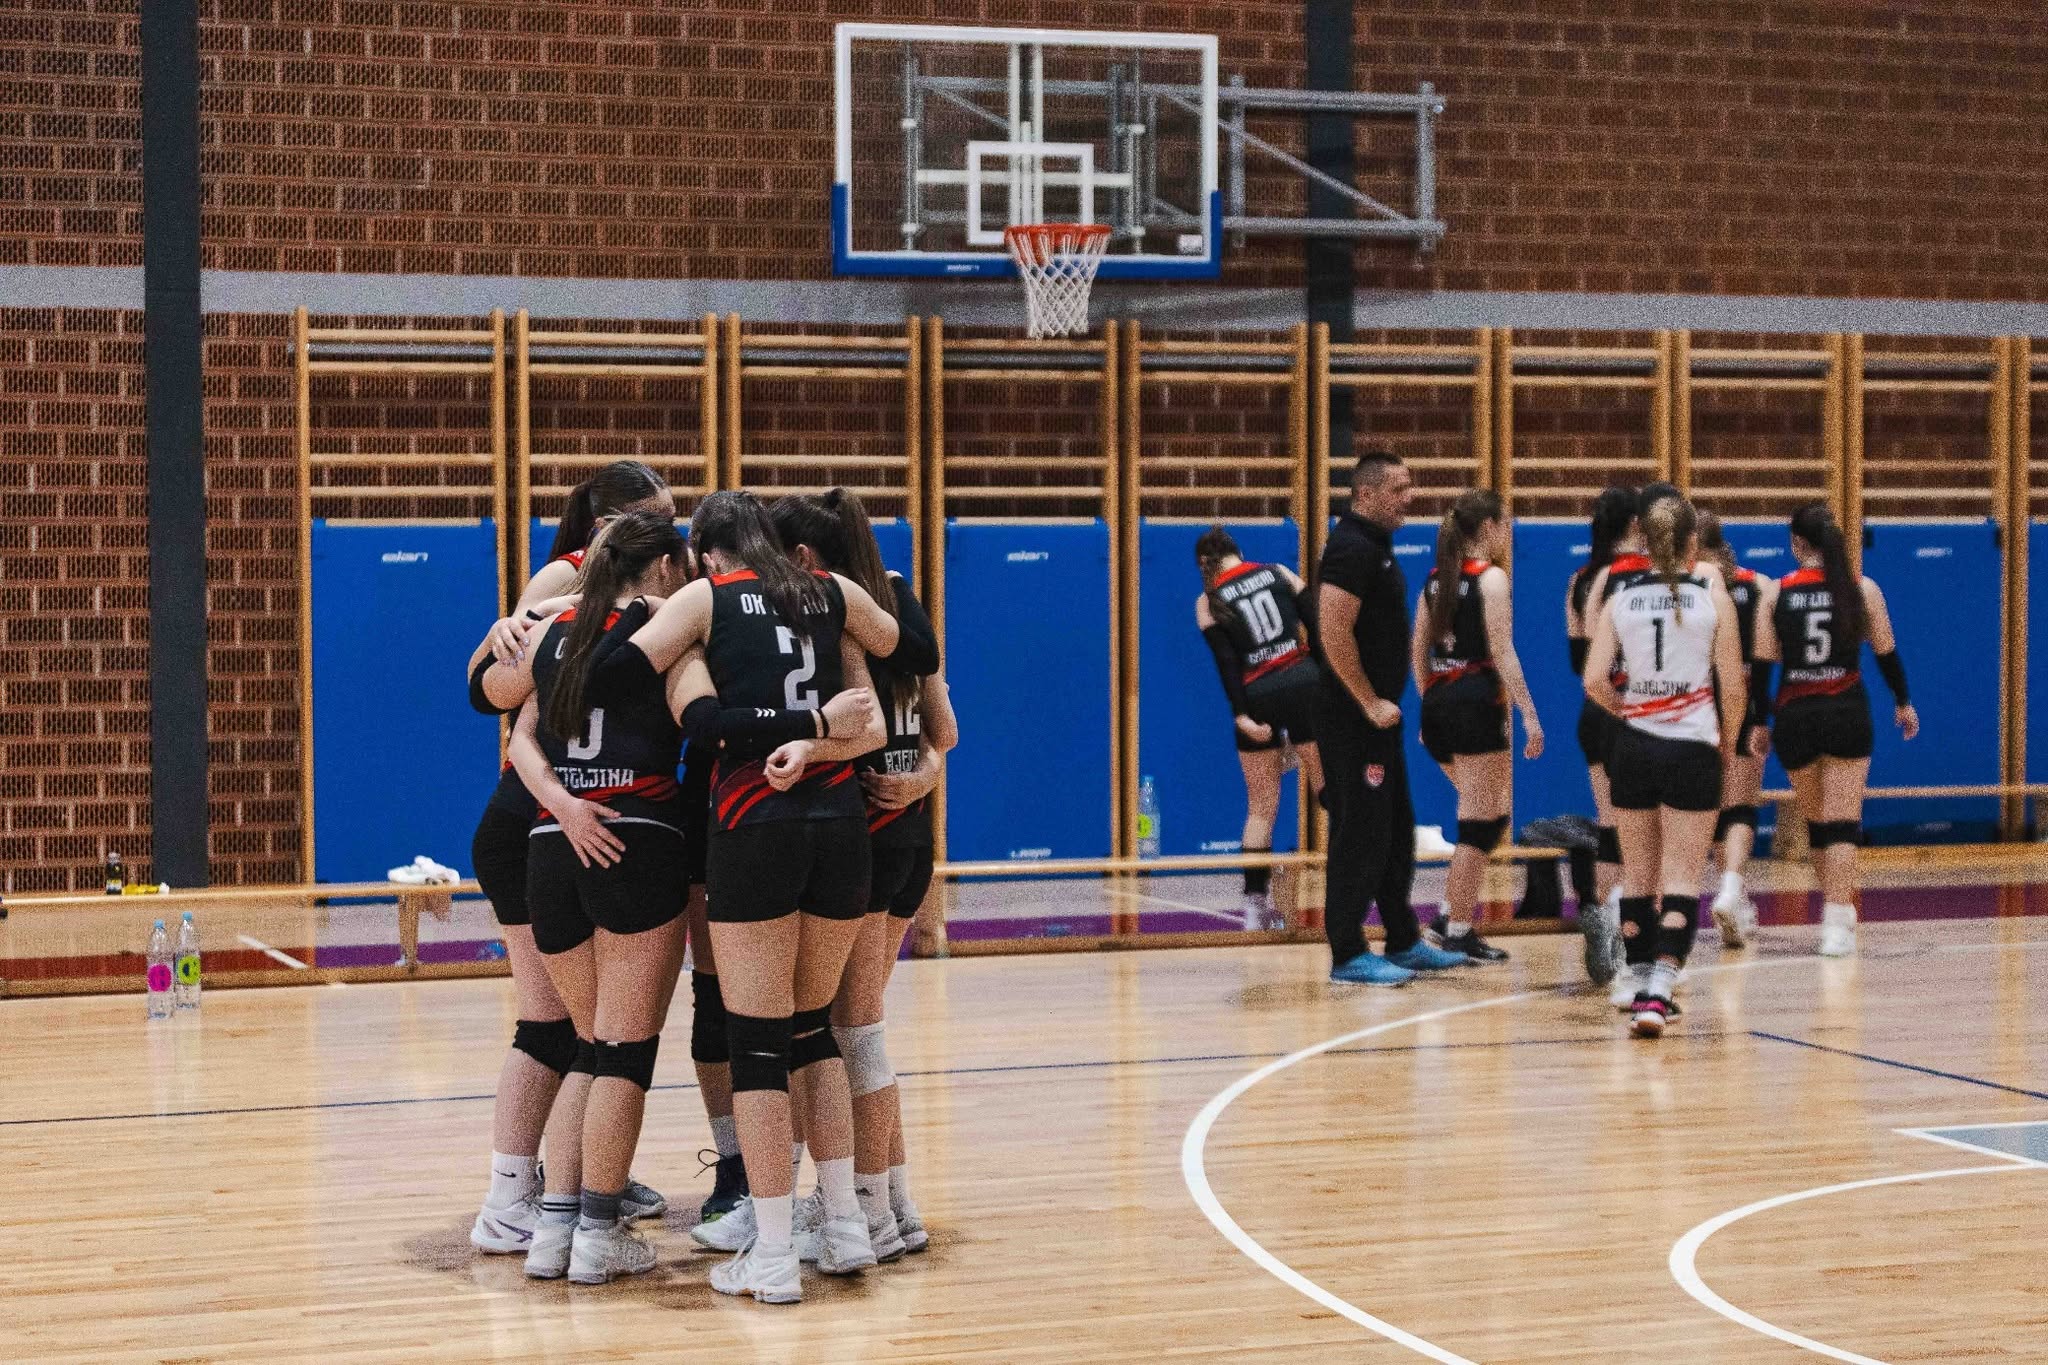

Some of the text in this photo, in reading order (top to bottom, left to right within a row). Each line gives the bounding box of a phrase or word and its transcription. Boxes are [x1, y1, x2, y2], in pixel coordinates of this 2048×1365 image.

[739, 592, 767, 616] OK
[1238, 588, 1284, 645] 10
[1652, 616, 1665, 673] 1
[1804, 611, 1833, 665] 5
[774, 625, 820, 711] 2
[553, 766, 635, 789] JELJINA
